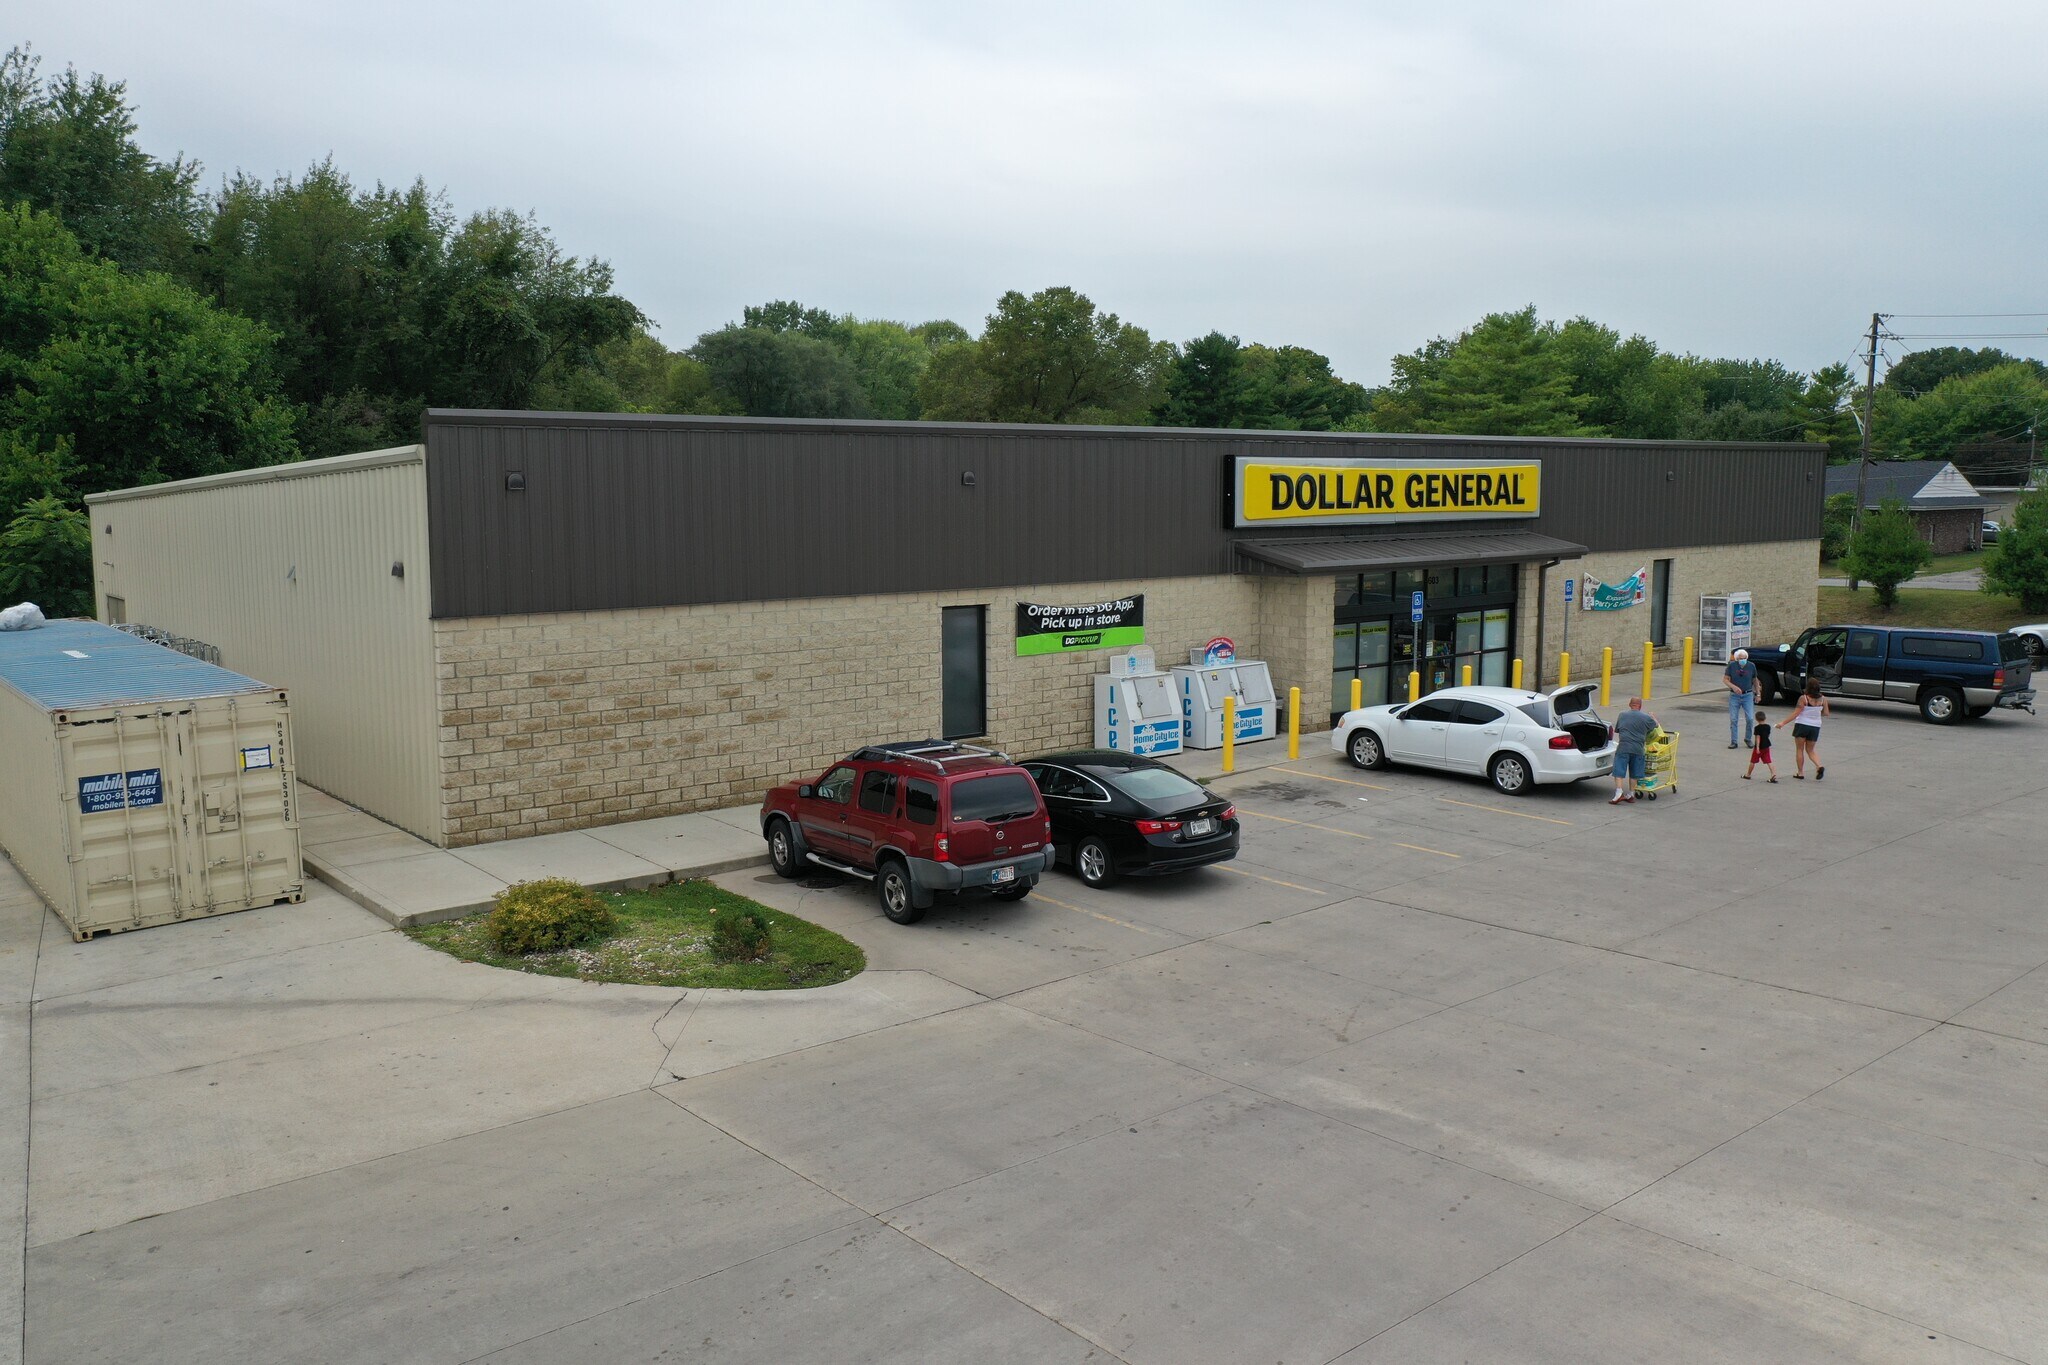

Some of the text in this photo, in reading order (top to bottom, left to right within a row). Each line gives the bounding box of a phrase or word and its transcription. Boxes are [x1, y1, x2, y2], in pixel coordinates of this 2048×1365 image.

[1269, 472, 1526, 511] DOLLAR GENERAL
[1027, 600, 1135, 616] Order in the DG App.
[1041, 614, 1122, 629] Pick up in store.
[1239, 718, 1252, 728] City
[1252, 718, 1263, 726] Ice
[1134, 730, 1179, 744] Home City Ice
[82, 771, 158, 794] mobile mini
[91, 797, 154, 811] mobilemni.com
